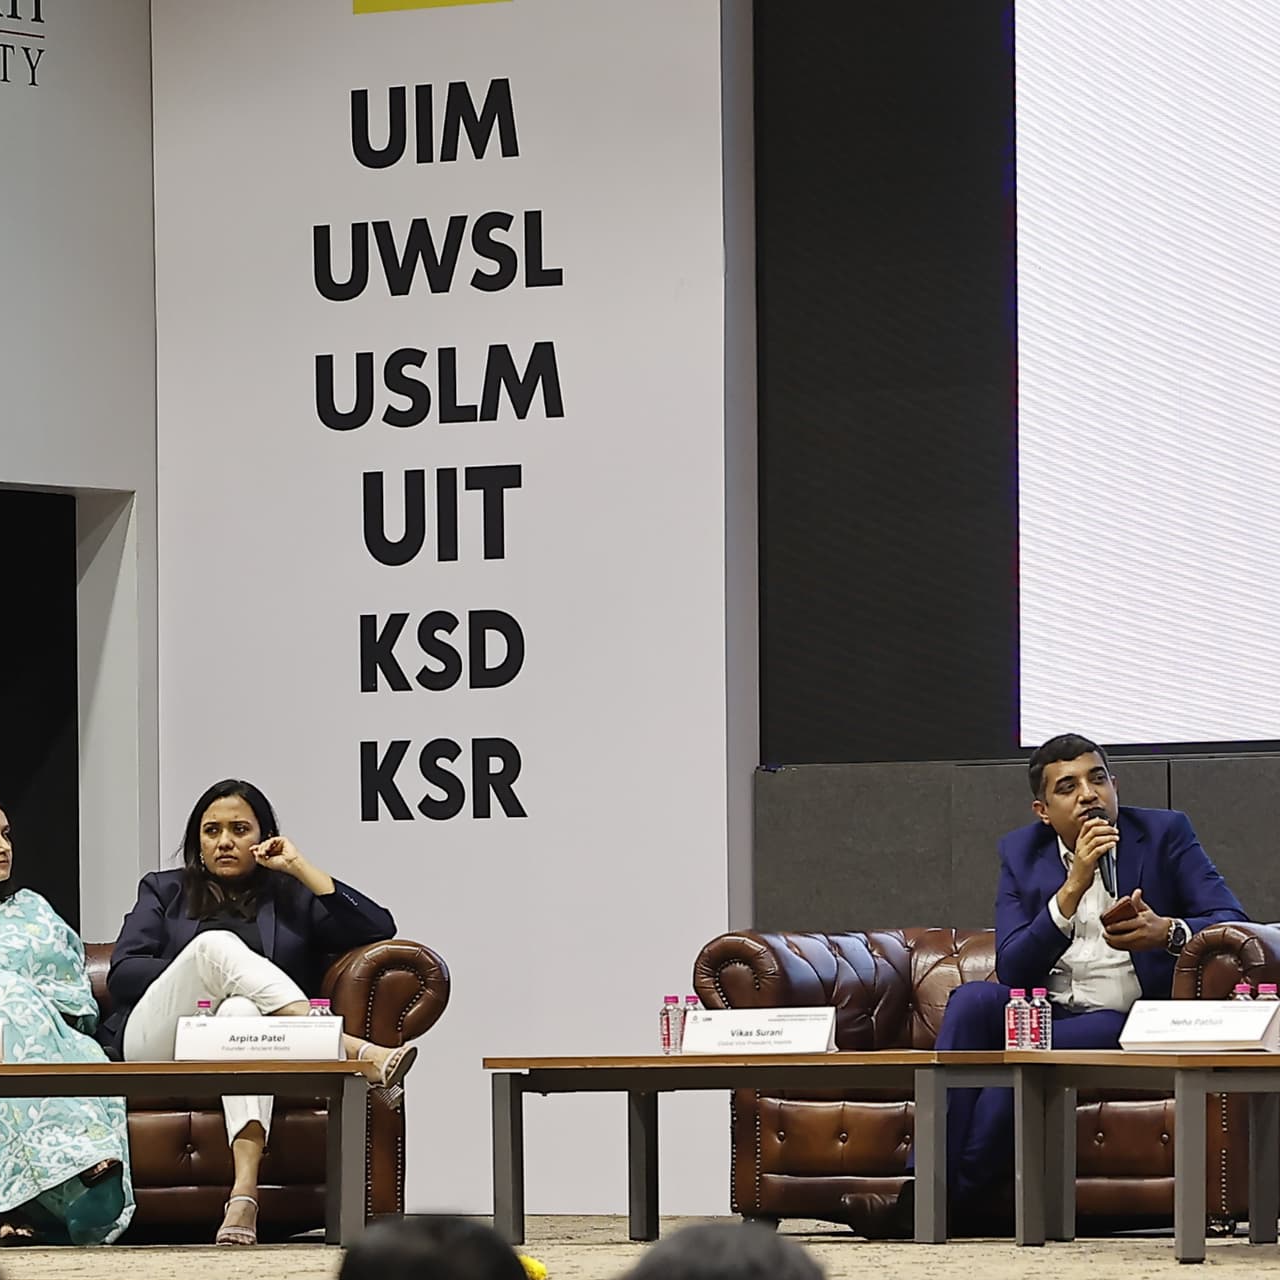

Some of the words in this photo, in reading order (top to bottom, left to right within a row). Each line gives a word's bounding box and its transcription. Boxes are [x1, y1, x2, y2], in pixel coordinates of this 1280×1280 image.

[350, 77, 520, 169] UIM
[313, 209, 563, 302] UWSL
[315, 341, 565, 431] USLM
[362, 464, 522, 567] UIT
[360, 609, 525, 693] KSD
[360, 737, 528, 821] KSR
[229, 1033, 259, 1044] Arpita
[261, 1033, 286, 1043] Patel
[731, 1028, 753, 1037] Vikas
[756, 1027, 783, 1037] Surani
